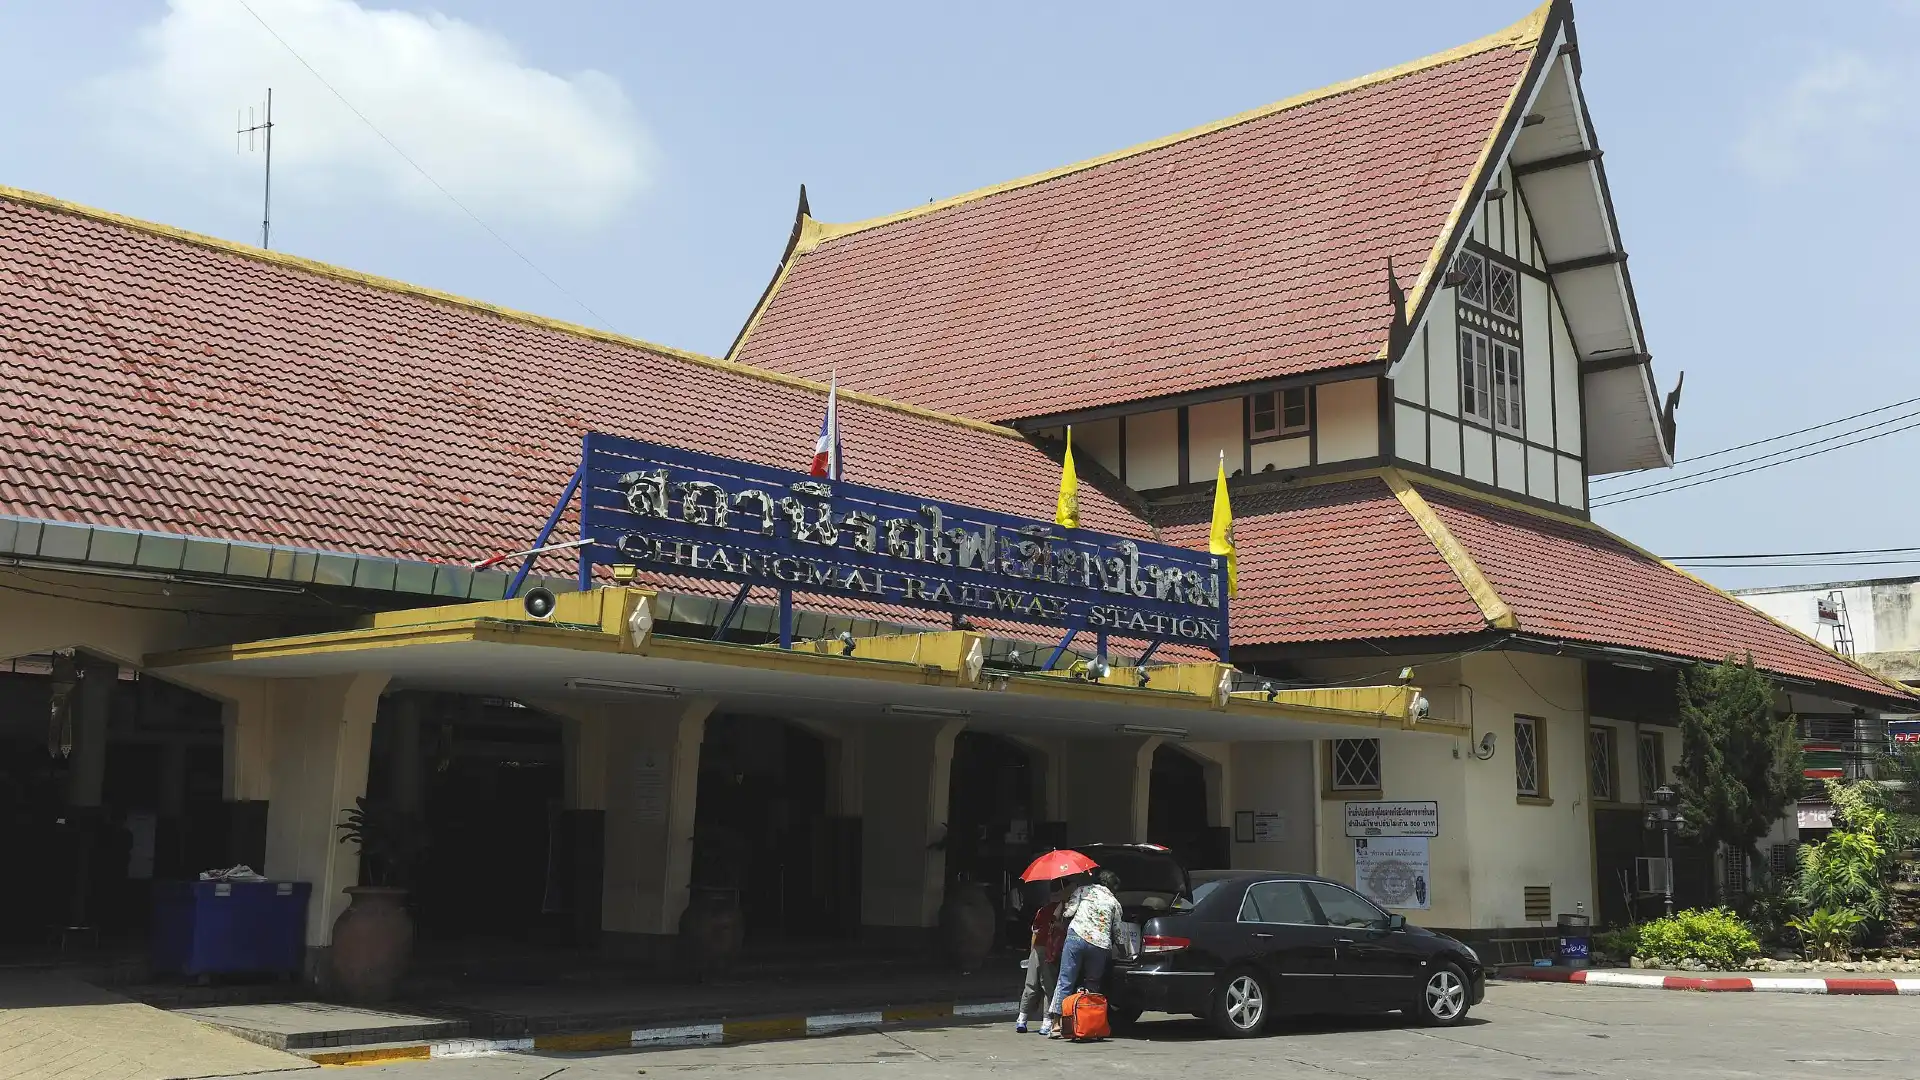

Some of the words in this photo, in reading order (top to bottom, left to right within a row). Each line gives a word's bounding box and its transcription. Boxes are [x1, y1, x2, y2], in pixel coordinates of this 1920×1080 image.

[616, 533, 886, 596] CHIANGMAI
[905, 576, 1069, 620] RAILWAY
[1088, 605, 1220, 641] STATION
[617, 468, 1219, 608] สถานีรถไฟเชียงใหม่
